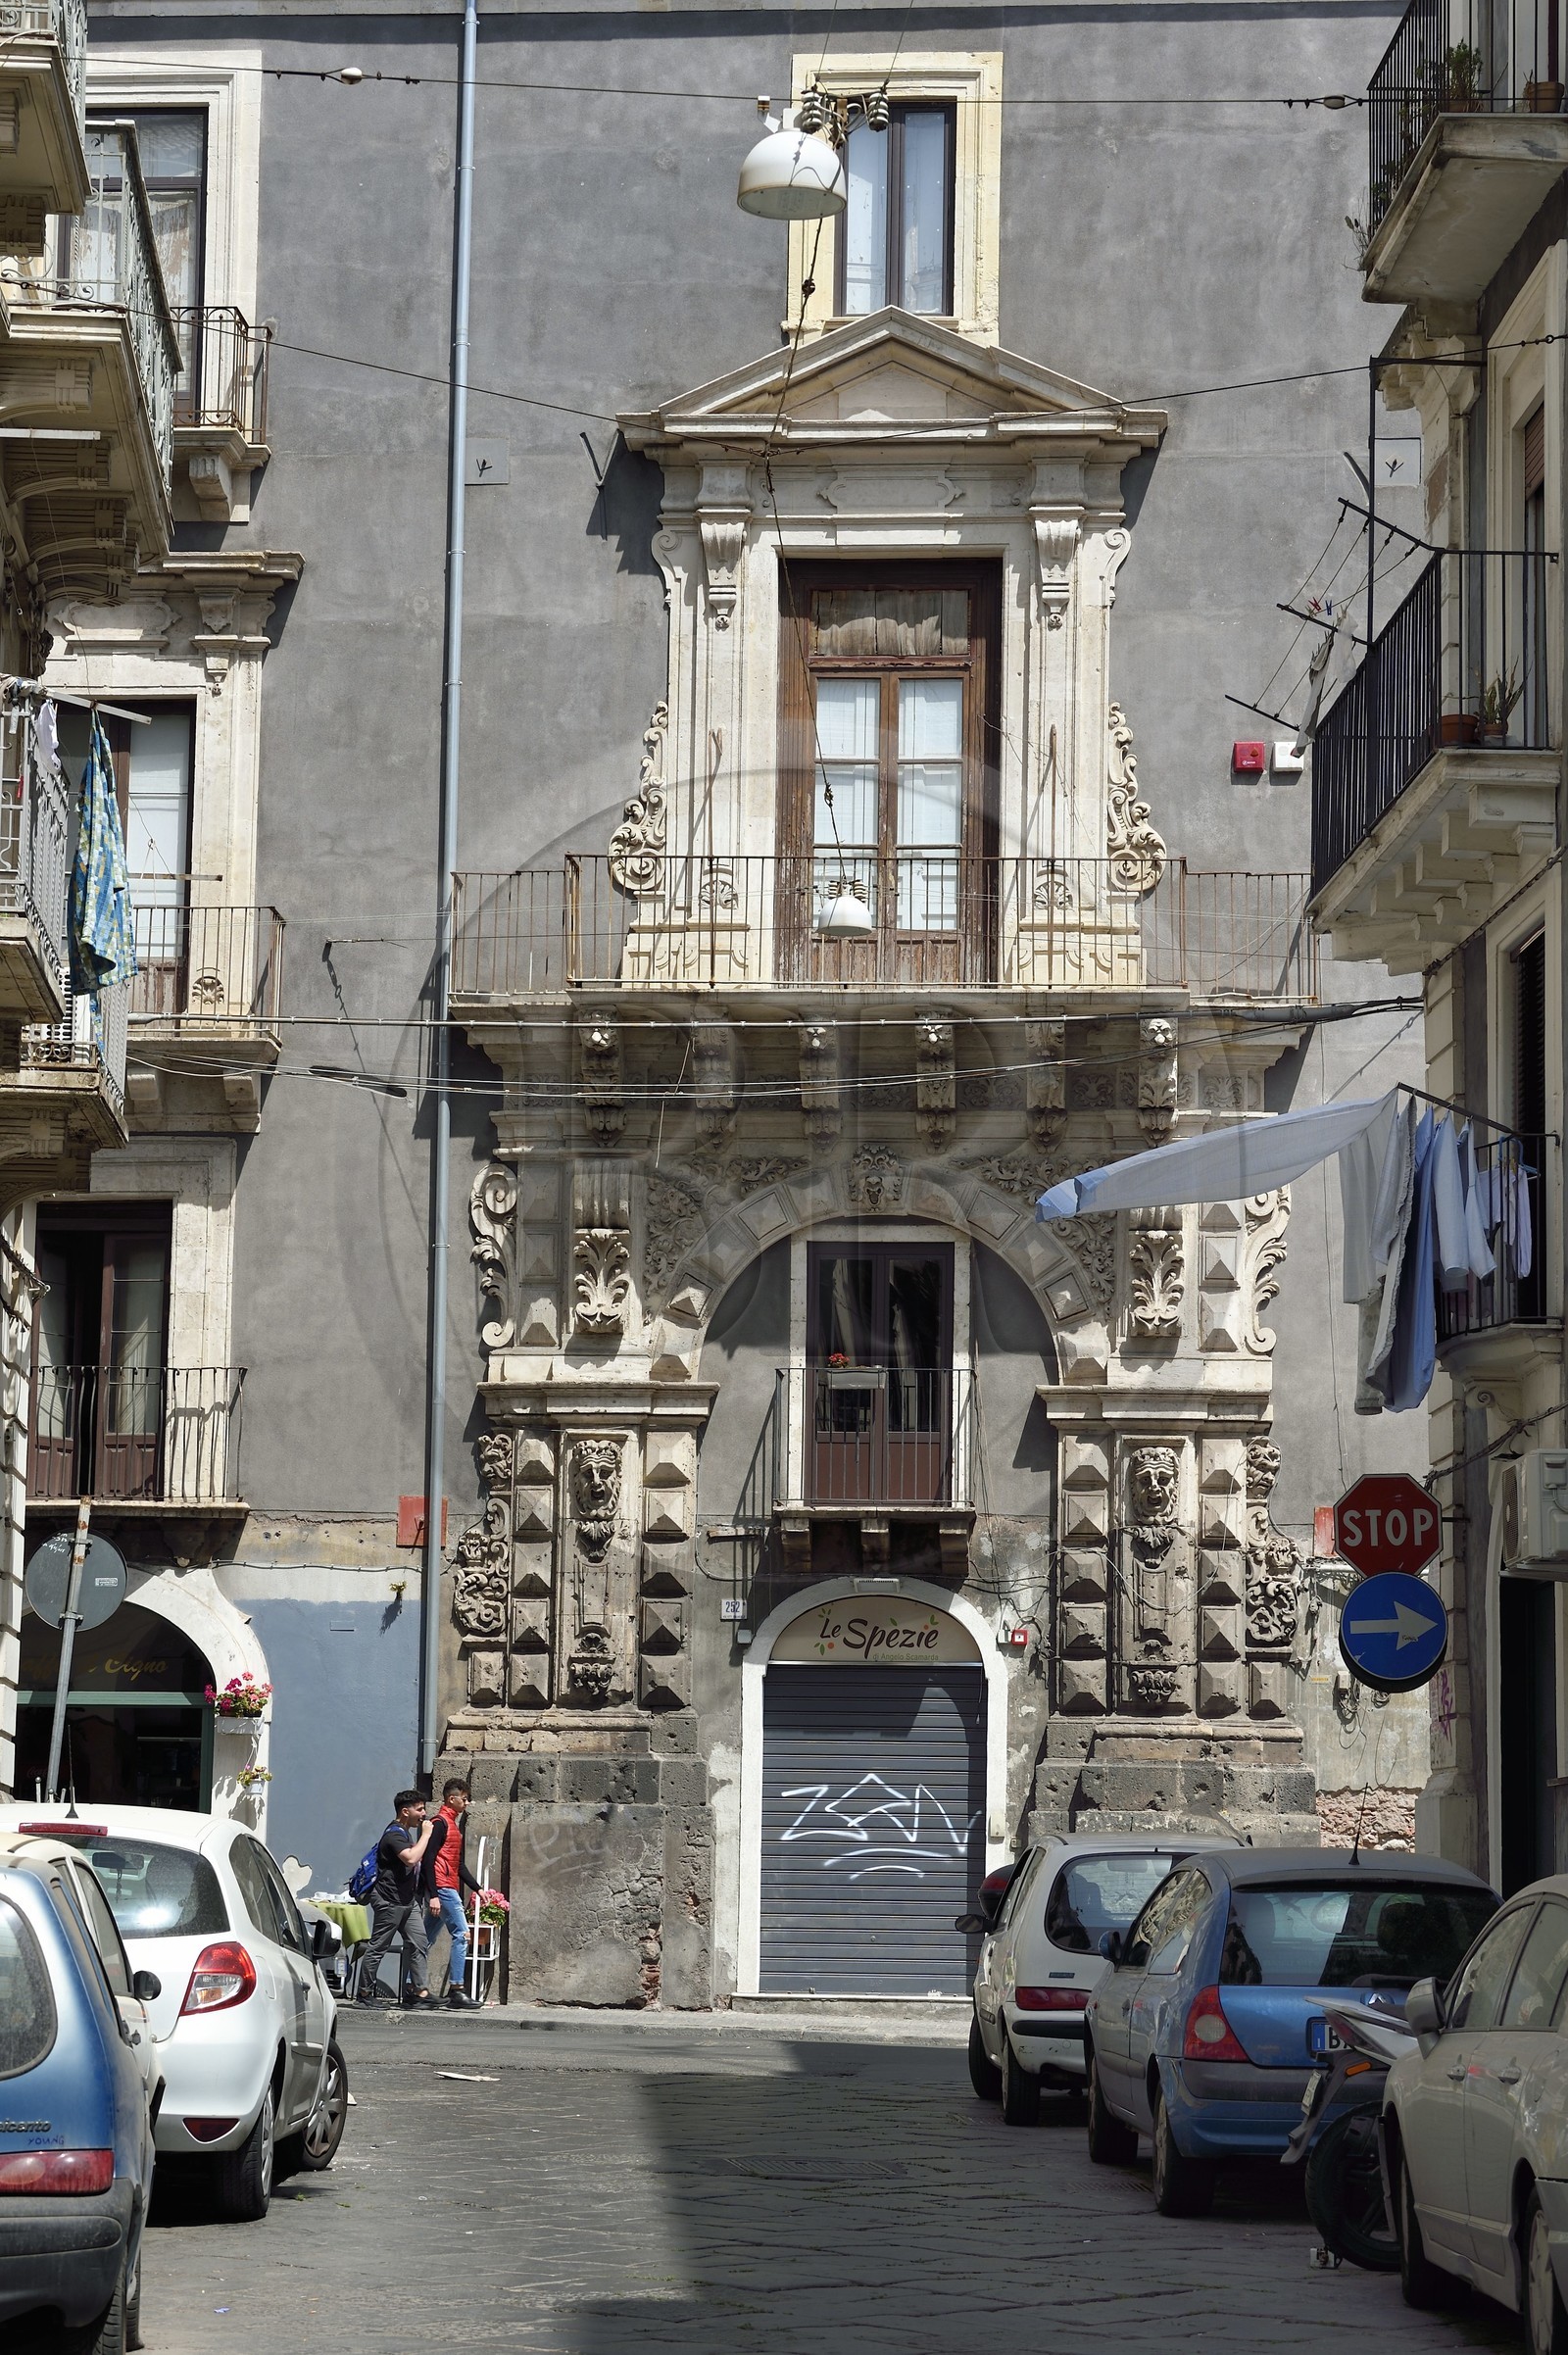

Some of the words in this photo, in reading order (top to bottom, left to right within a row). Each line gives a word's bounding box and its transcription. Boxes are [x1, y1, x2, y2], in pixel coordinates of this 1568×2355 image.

[1343, 1508, 1434, 1547] STOP
[725, 1600, 741, 1613] 252
[819, 1617, 842, 1639] Le
[842, 1617, 940, 1659] Spezie
[881, 1652, 905, 1661] Angelo
[906, 1652, 939, 1661] Scamarda
[27, 2134, 65, 2145] YOUNG
